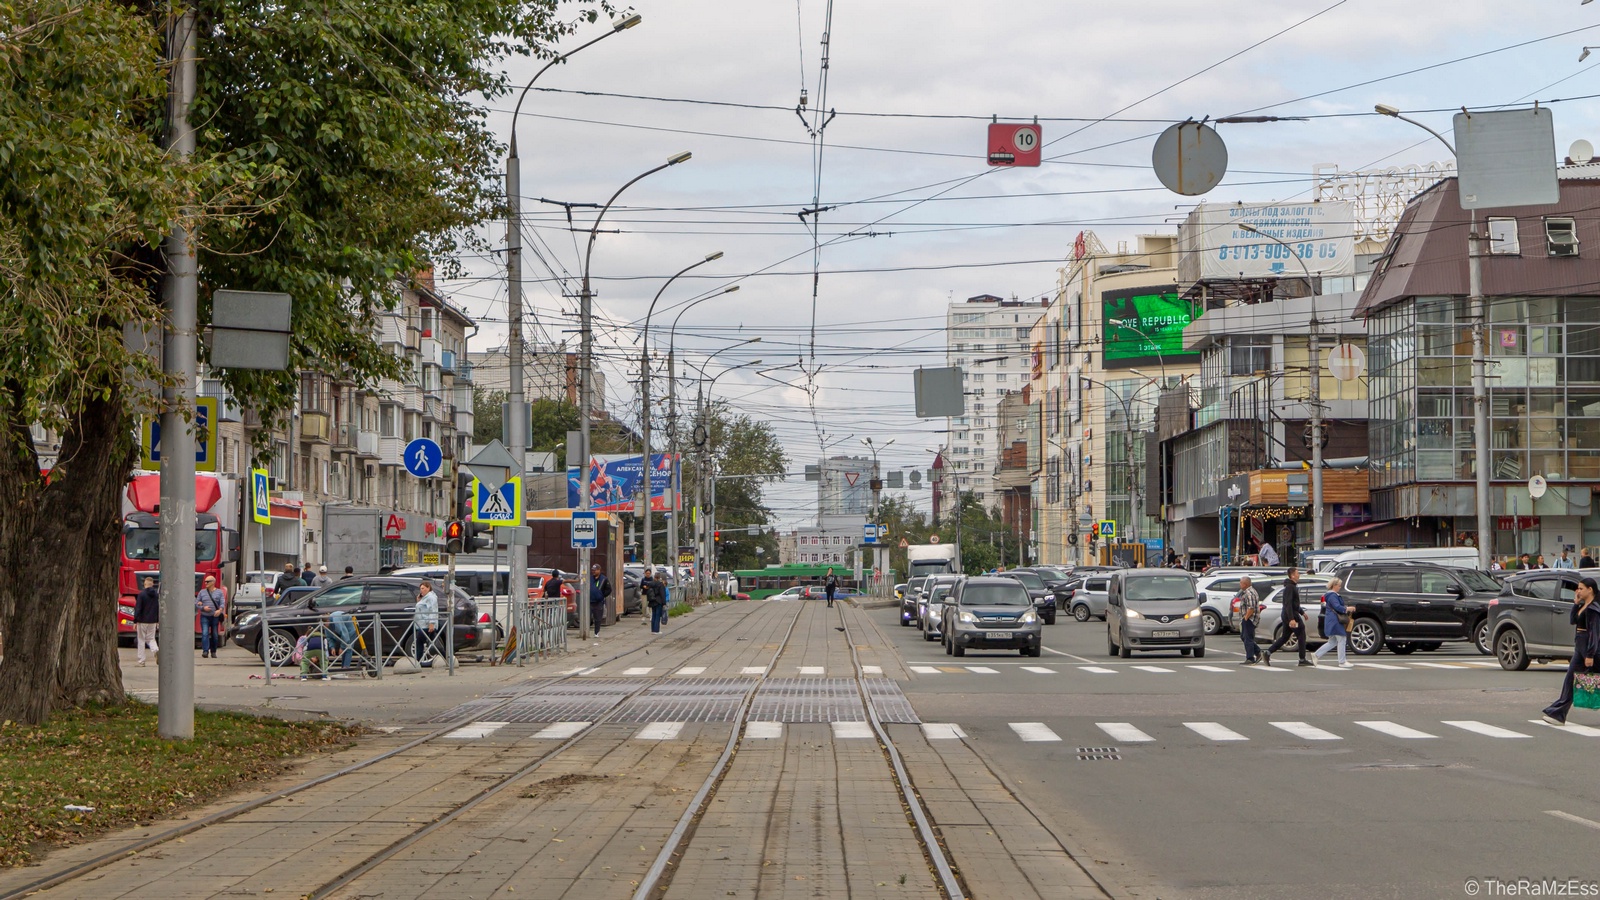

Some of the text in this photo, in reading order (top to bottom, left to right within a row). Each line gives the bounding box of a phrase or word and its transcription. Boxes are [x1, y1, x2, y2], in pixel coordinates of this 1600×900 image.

[1018, 133, 1033, 145] 10
[1229, 206, 1260, 217] ЗАЙМЫ
[1262, 206, 1279, 217] ПОД
[1280, 206, 1306, 217] ЗАЛОГ
[1286, 227, 1324, 239] ИЗДЕЛИЯ
[1219, 242, 1337, 261] 8-913-905-36-05
[1142, 314, 1190, 327] REPUBLIC
